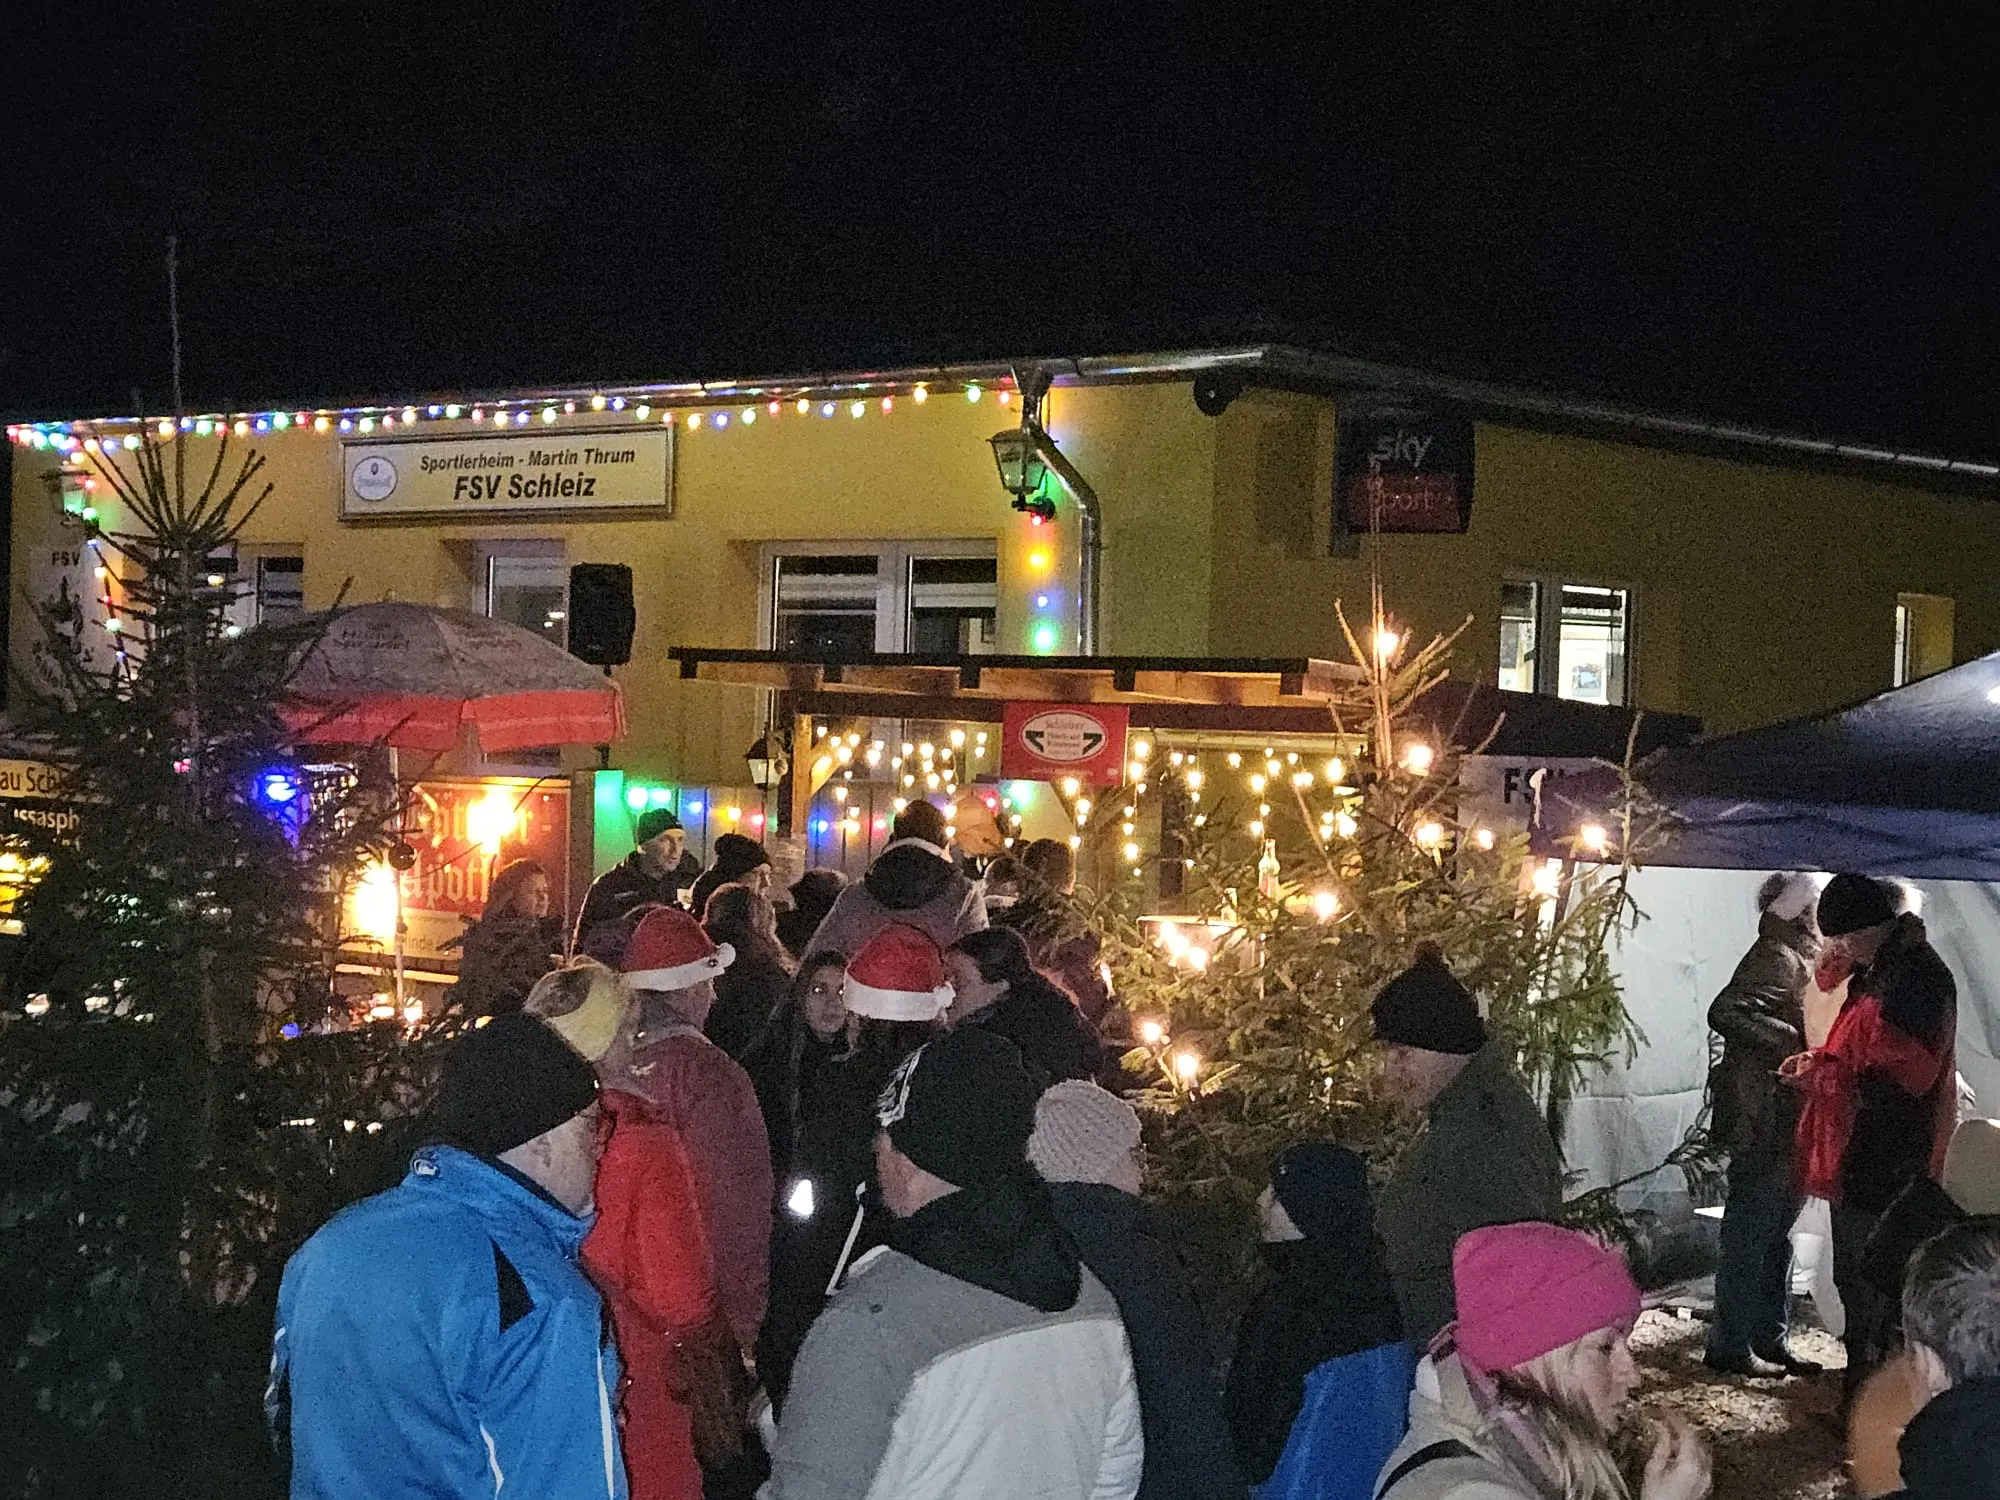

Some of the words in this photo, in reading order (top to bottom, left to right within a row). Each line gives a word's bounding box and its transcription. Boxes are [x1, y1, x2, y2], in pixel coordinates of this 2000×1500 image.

[420, 451, 514, 474] Sportlerheim
[528, 449, 578, 466] Martin
[584, 448, 635, 464] Thrum
[454, 475, 502, 500] FSV
[508, 472, 596, 498] Schleiz
[51, 552, 81, 567] FSV
